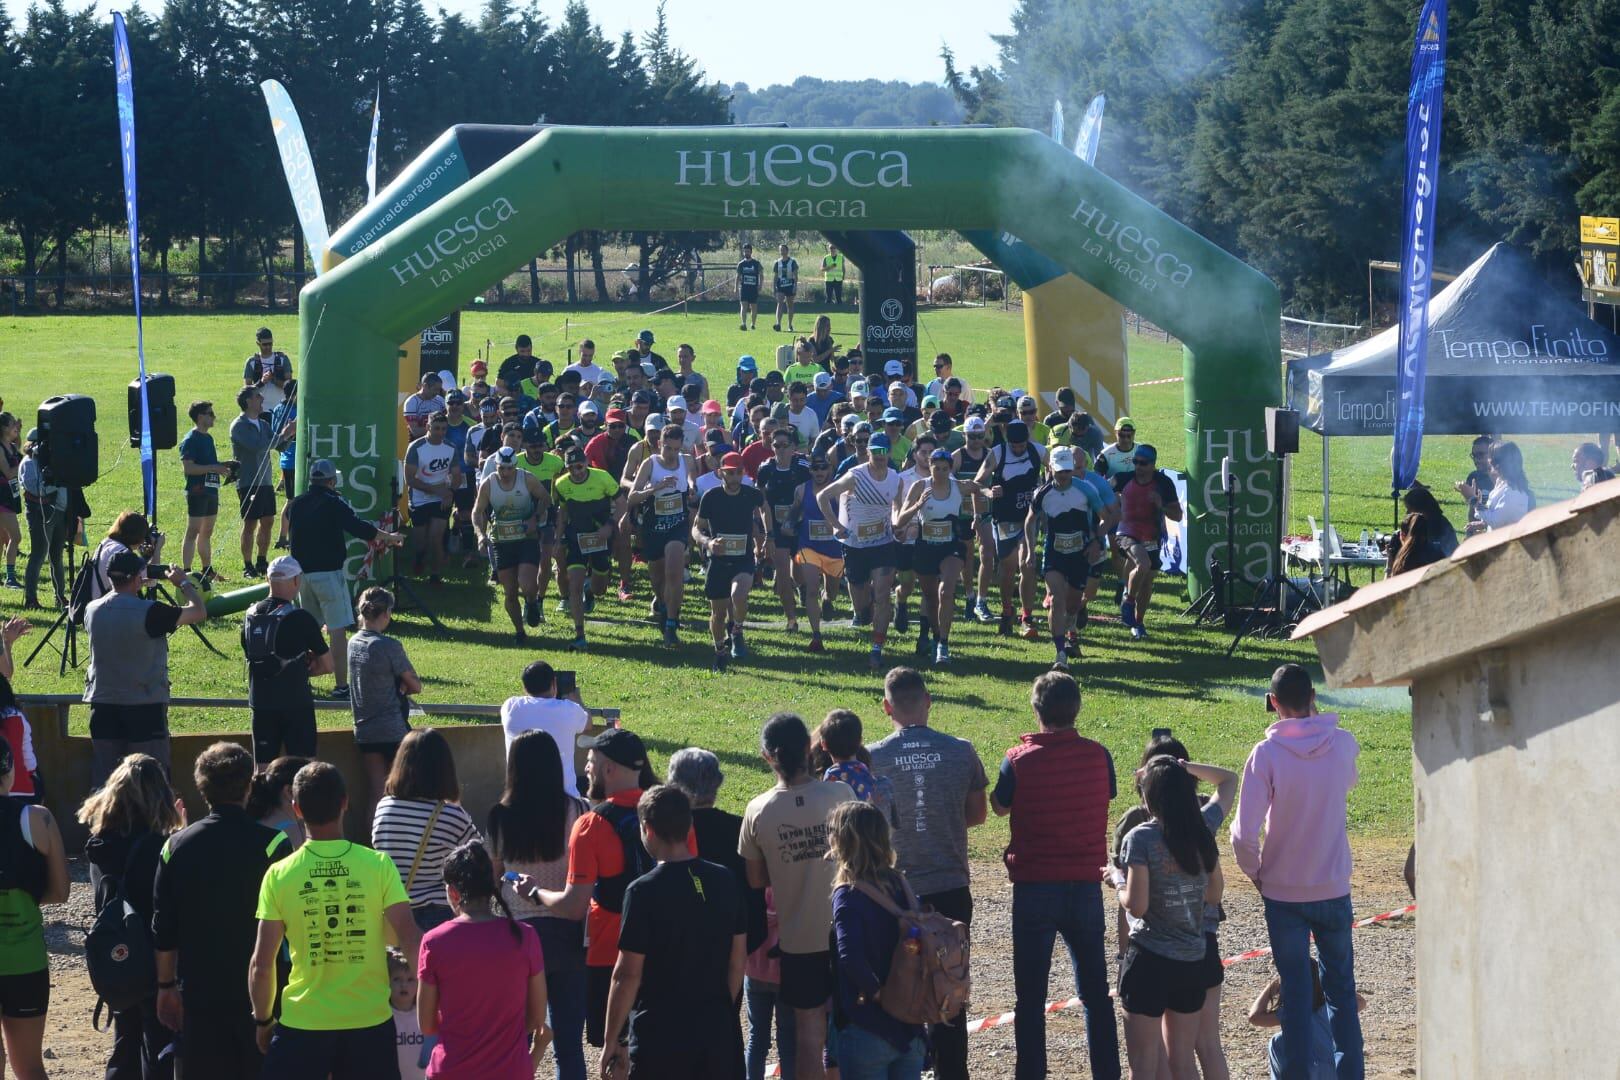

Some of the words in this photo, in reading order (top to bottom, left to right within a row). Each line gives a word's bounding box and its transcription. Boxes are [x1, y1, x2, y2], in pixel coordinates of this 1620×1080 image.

[674, 144, 912, 187] Huesca
[350, 152, 457, 254] cajaruraldearagon.es
[389, 197, 519, 287] Huesca
[1070, 199, 1193, 288] Huesca
[866, 323, 915, 339] raster
[1435, 324, 1608, 365] TempoFinito
[309, 423, 380, 459] Hu
[895, 752, 941, 765] Huesca
